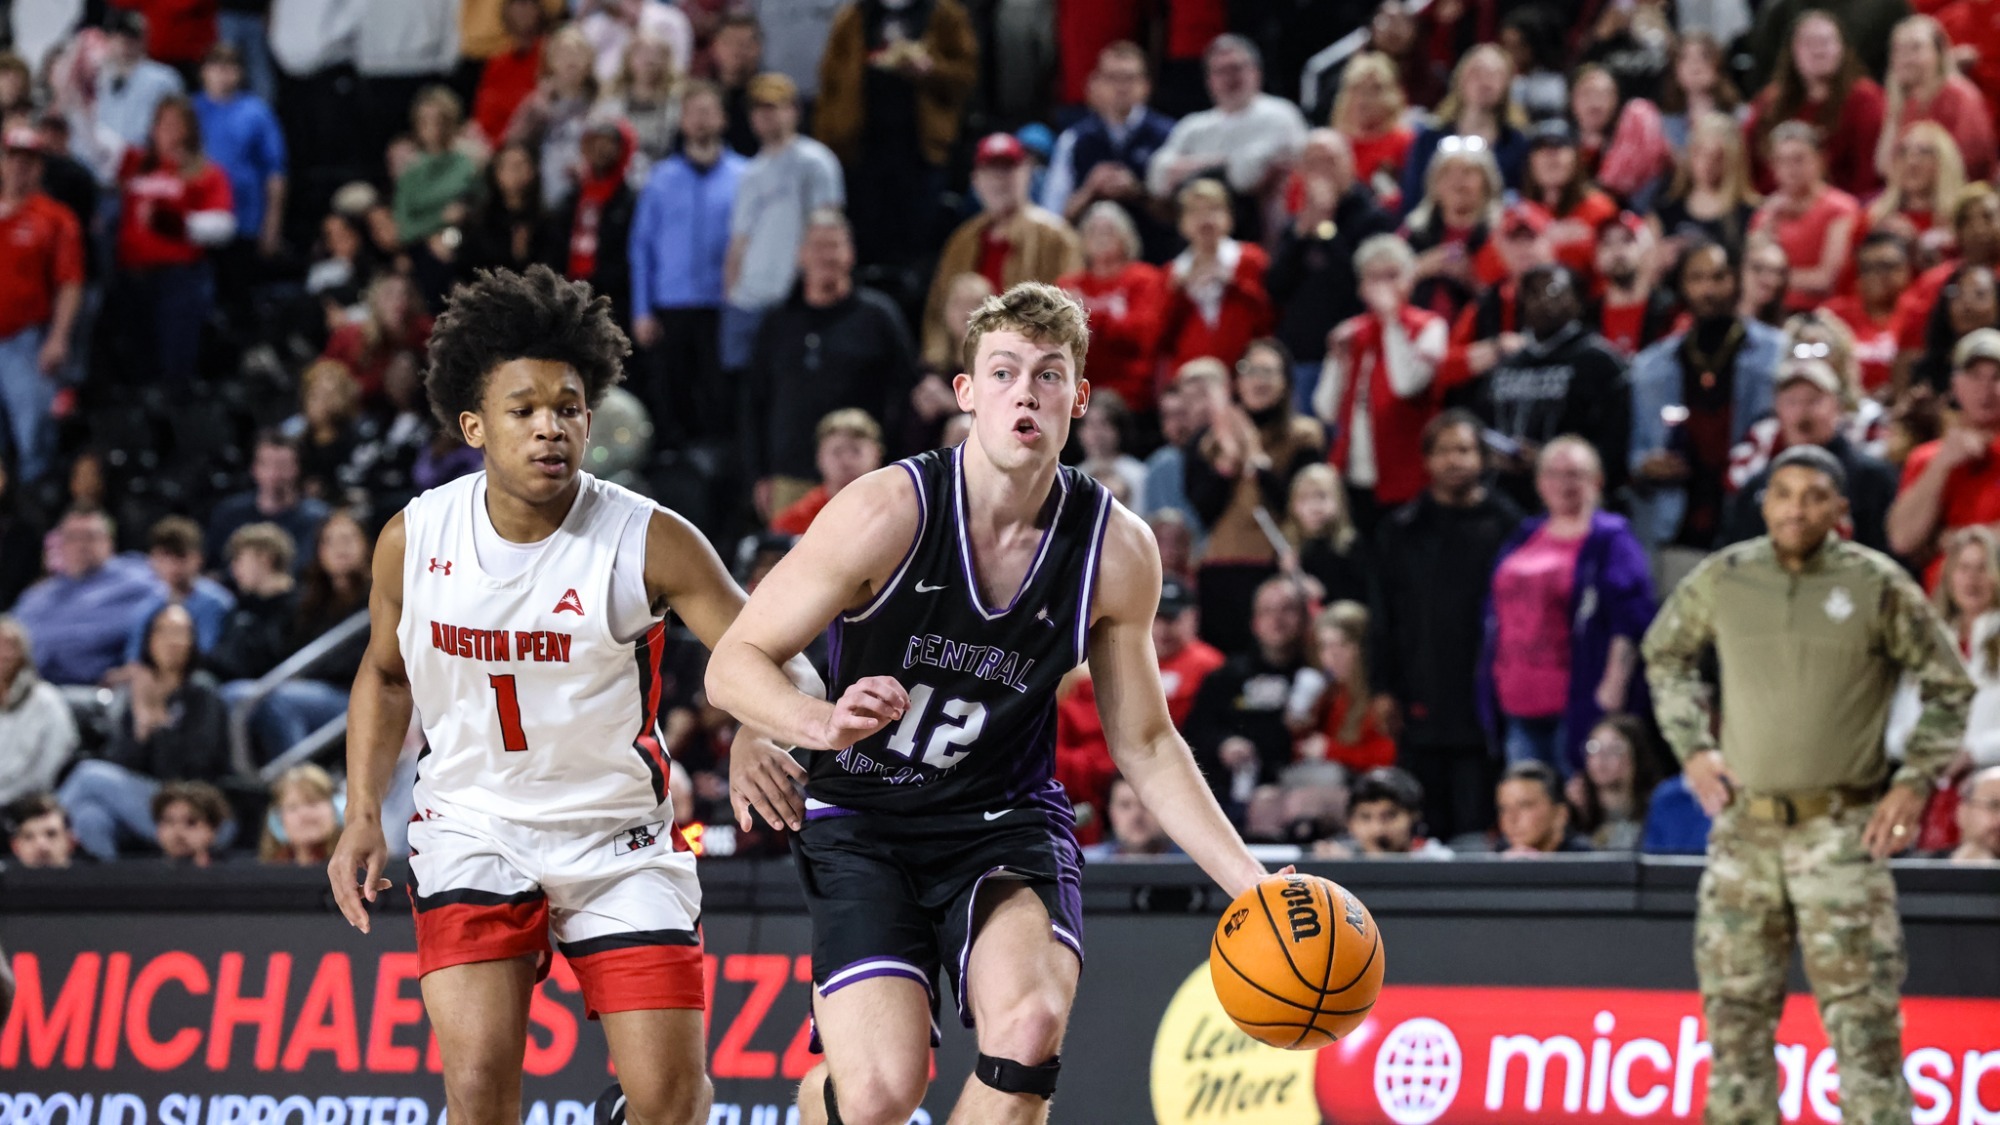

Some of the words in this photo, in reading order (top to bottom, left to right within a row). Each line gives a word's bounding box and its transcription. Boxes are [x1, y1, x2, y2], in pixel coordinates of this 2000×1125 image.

[430, 620, 510, 662] AUSTIN
[514, 630, 572, 663] PEAY
[902, 633, 1035, 694] CENTRAL
[488, 672, 528, 752] 1
[885, 682, 988, 770] 12
[1280, 873, 1322, 943] Wils
[0, 950, 579, 1077] MICHAES
[1183, 1012, 1260, 1061] Lea
[1184, 1069, 1298, 1120] More
[1484, 1010, 2000, 1125] michaesp
